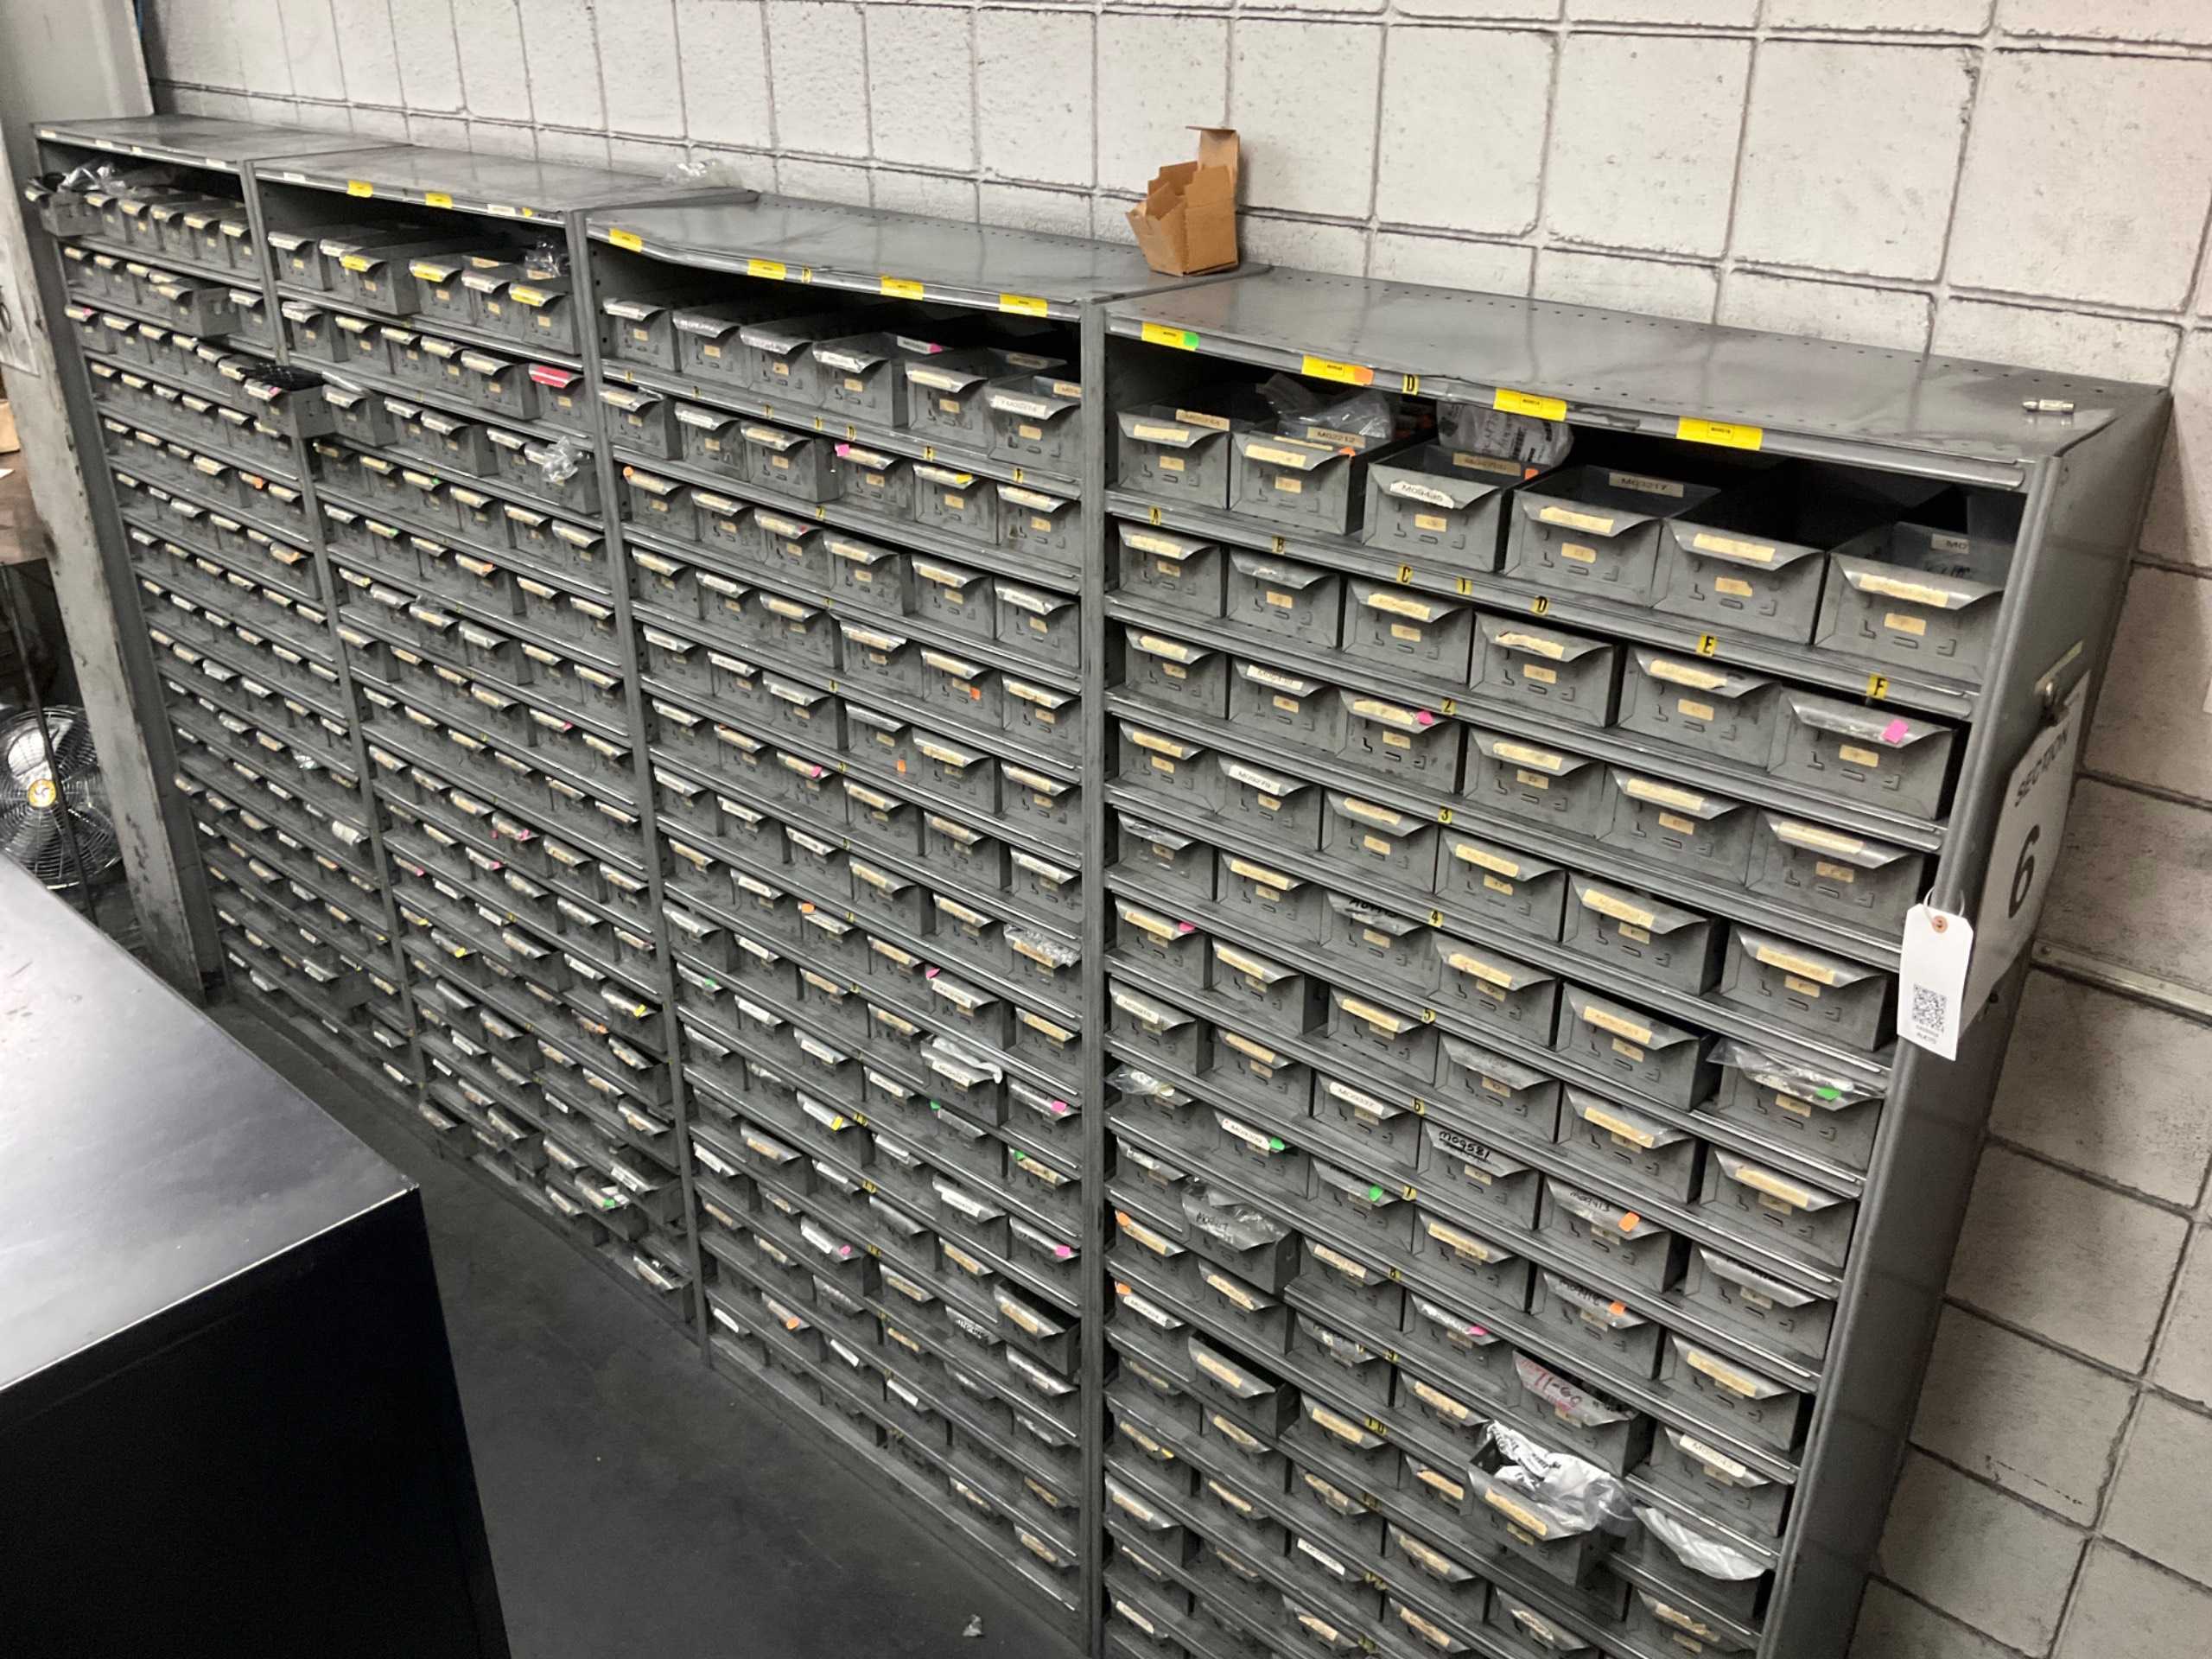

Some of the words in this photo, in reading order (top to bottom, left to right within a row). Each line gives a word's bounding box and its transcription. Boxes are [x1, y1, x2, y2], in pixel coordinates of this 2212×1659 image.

[1406, 376, 1415, 392] D
[1276, 537, 1285, 553] B
[1401, 566, 1412, 584] C
[1535, 595, 1548, 614] D
[1703, 635, 1715, 656] E
[1873, 677, 1886, 696] F
[1441, 696, 1453, 715] 2
[2015, 728, 2069, 807] SECTION
[1440, 807, 1449, 822] 3
[2008, 823, 2040, 918] 6
[1430, 910, 1440, 925] 4
[1423, 1009, 1432, 1024] 5
[1413, 1099, 1421, 1113] 6
